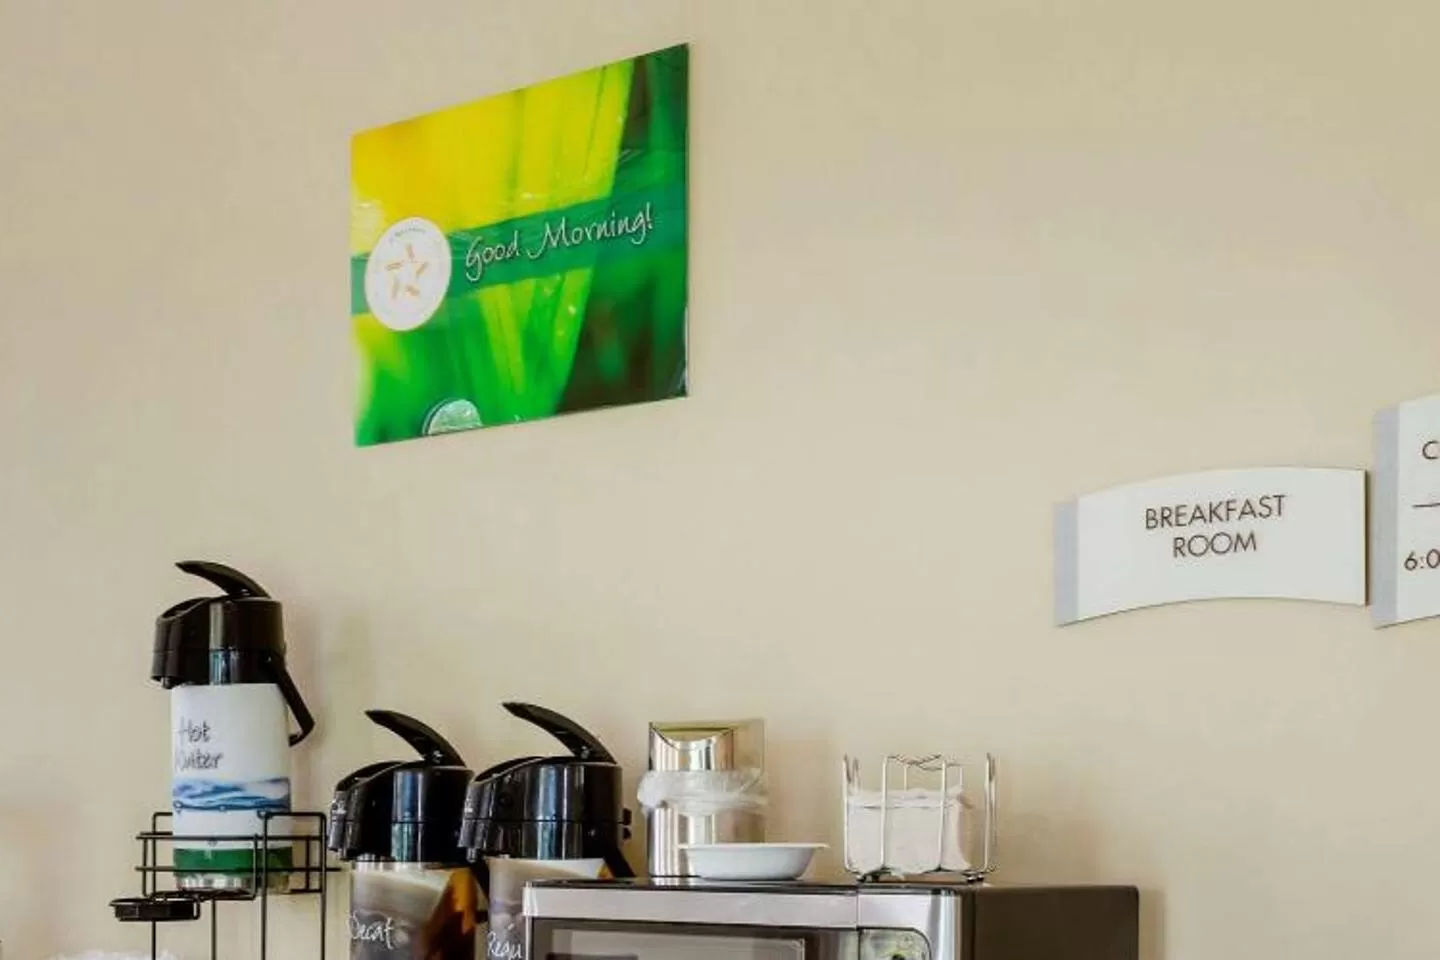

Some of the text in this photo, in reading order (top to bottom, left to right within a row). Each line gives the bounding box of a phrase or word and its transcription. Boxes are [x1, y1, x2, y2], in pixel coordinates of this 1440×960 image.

[465, 202, 653, 283] Good Morning!
[1145, 494, 1287, 530] BREAKFAST
[1172, 531, 1258, 558] ROOM
[176, 716, 212, 743] Hot
